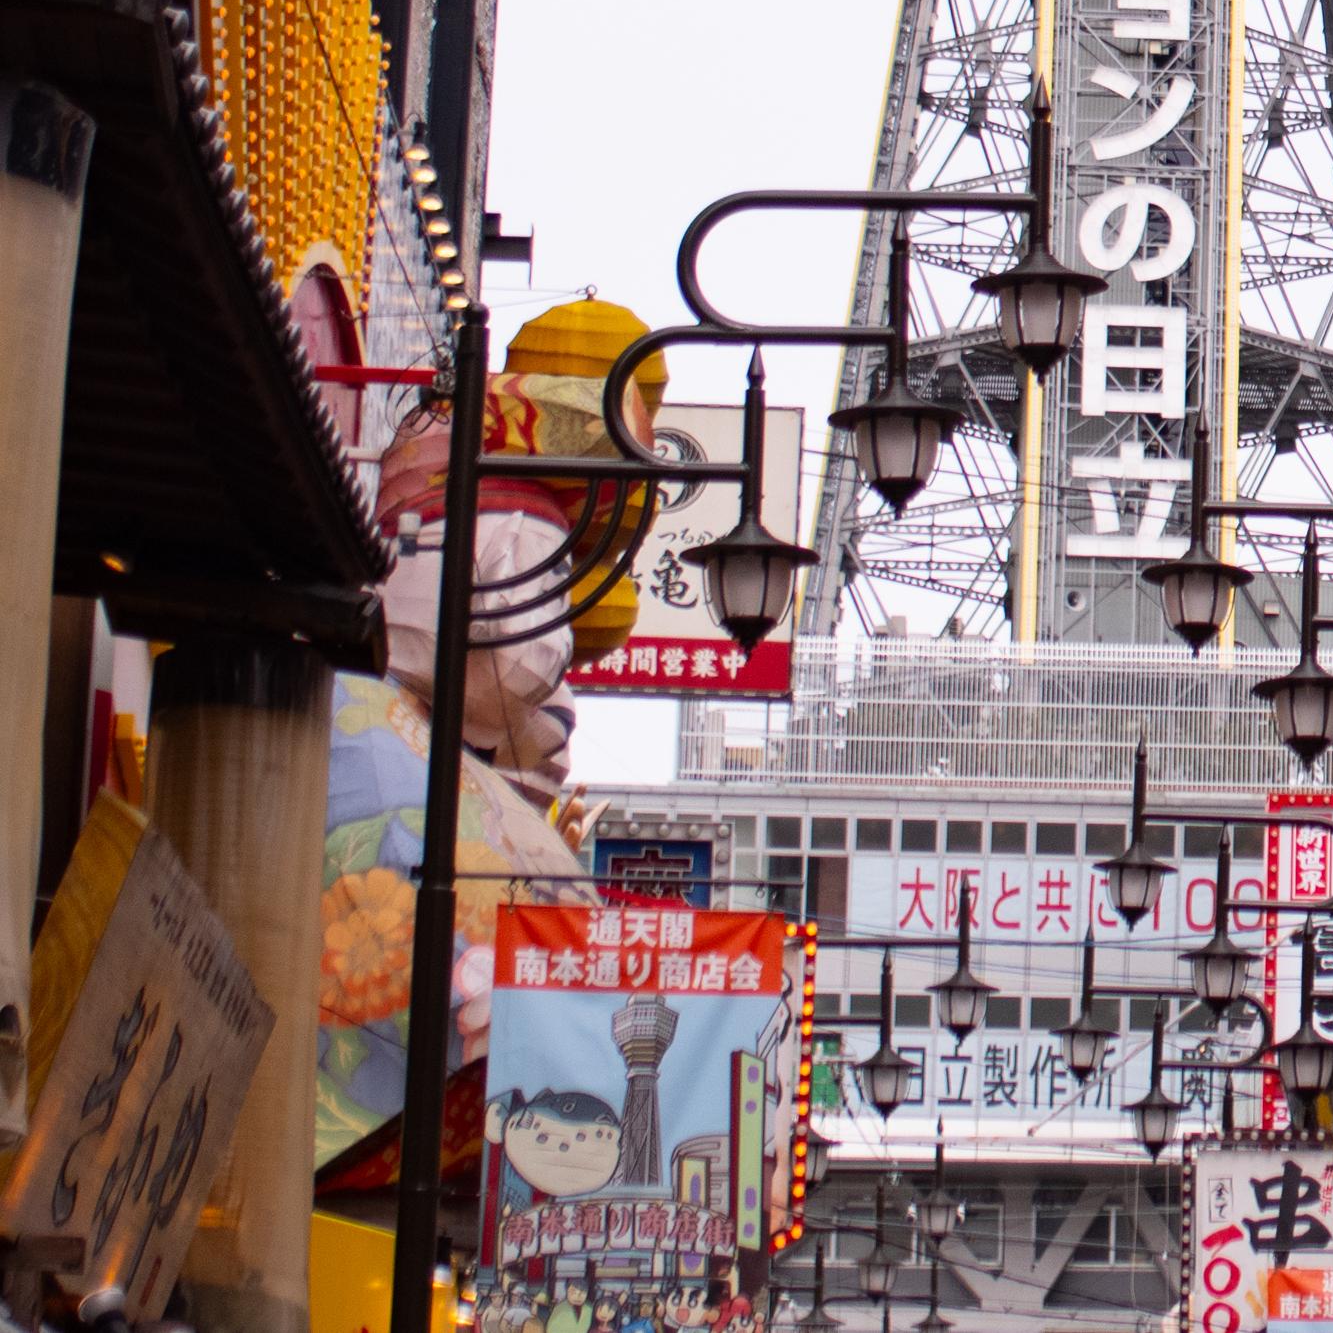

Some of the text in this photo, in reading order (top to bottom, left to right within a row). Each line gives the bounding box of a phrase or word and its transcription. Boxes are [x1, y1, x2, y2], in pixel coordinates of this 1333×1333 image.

[566, 646, 747, 680] 時間営業中
[587, 910, 694, 949] 通天閣
[515, 946, 763, 992] 南本通り商店会
[504, 1204, 736, 1248] 南本通り商店街
[1242, 1160, 1333, 1271] 串
